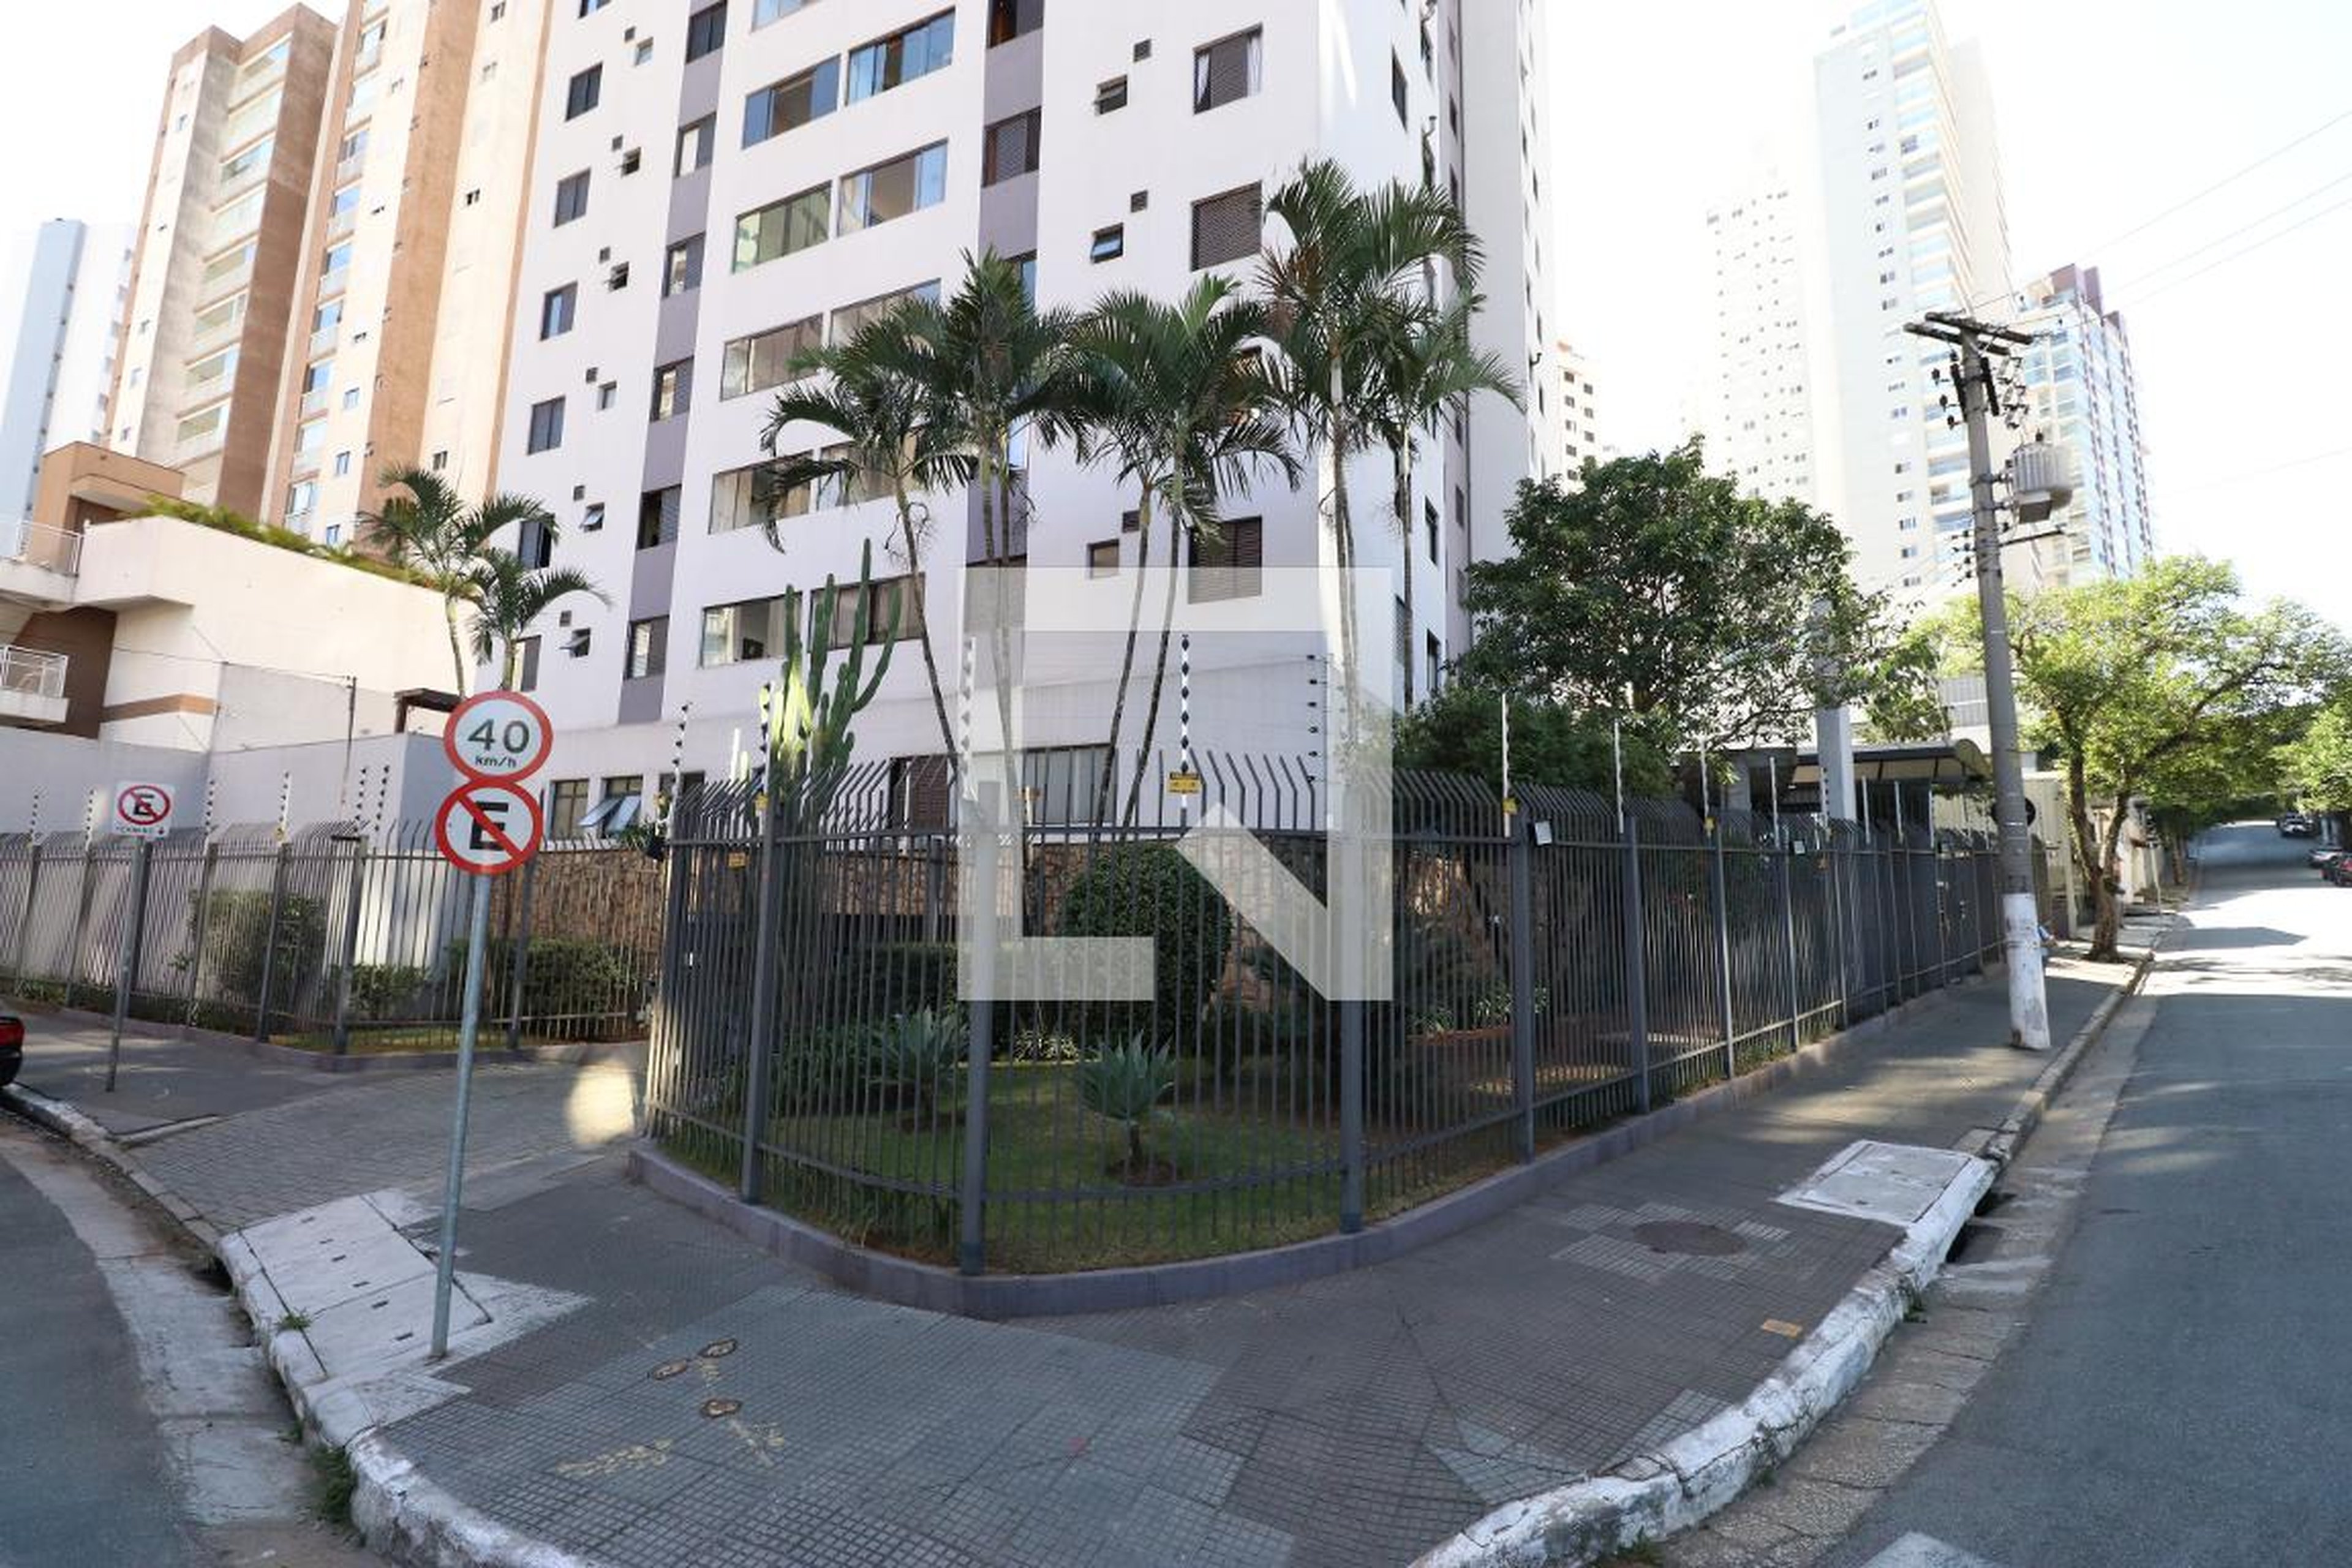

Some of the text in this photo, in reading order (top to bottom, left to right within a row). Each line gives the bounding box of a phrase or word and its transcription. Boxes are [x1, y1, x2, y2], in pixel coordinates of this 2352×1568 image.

[467, 718, 530, 753] 40
[475, 755, 517, 768] km/h
[134, 794, 154, 815] E
[470, 802, 508, 850] E
